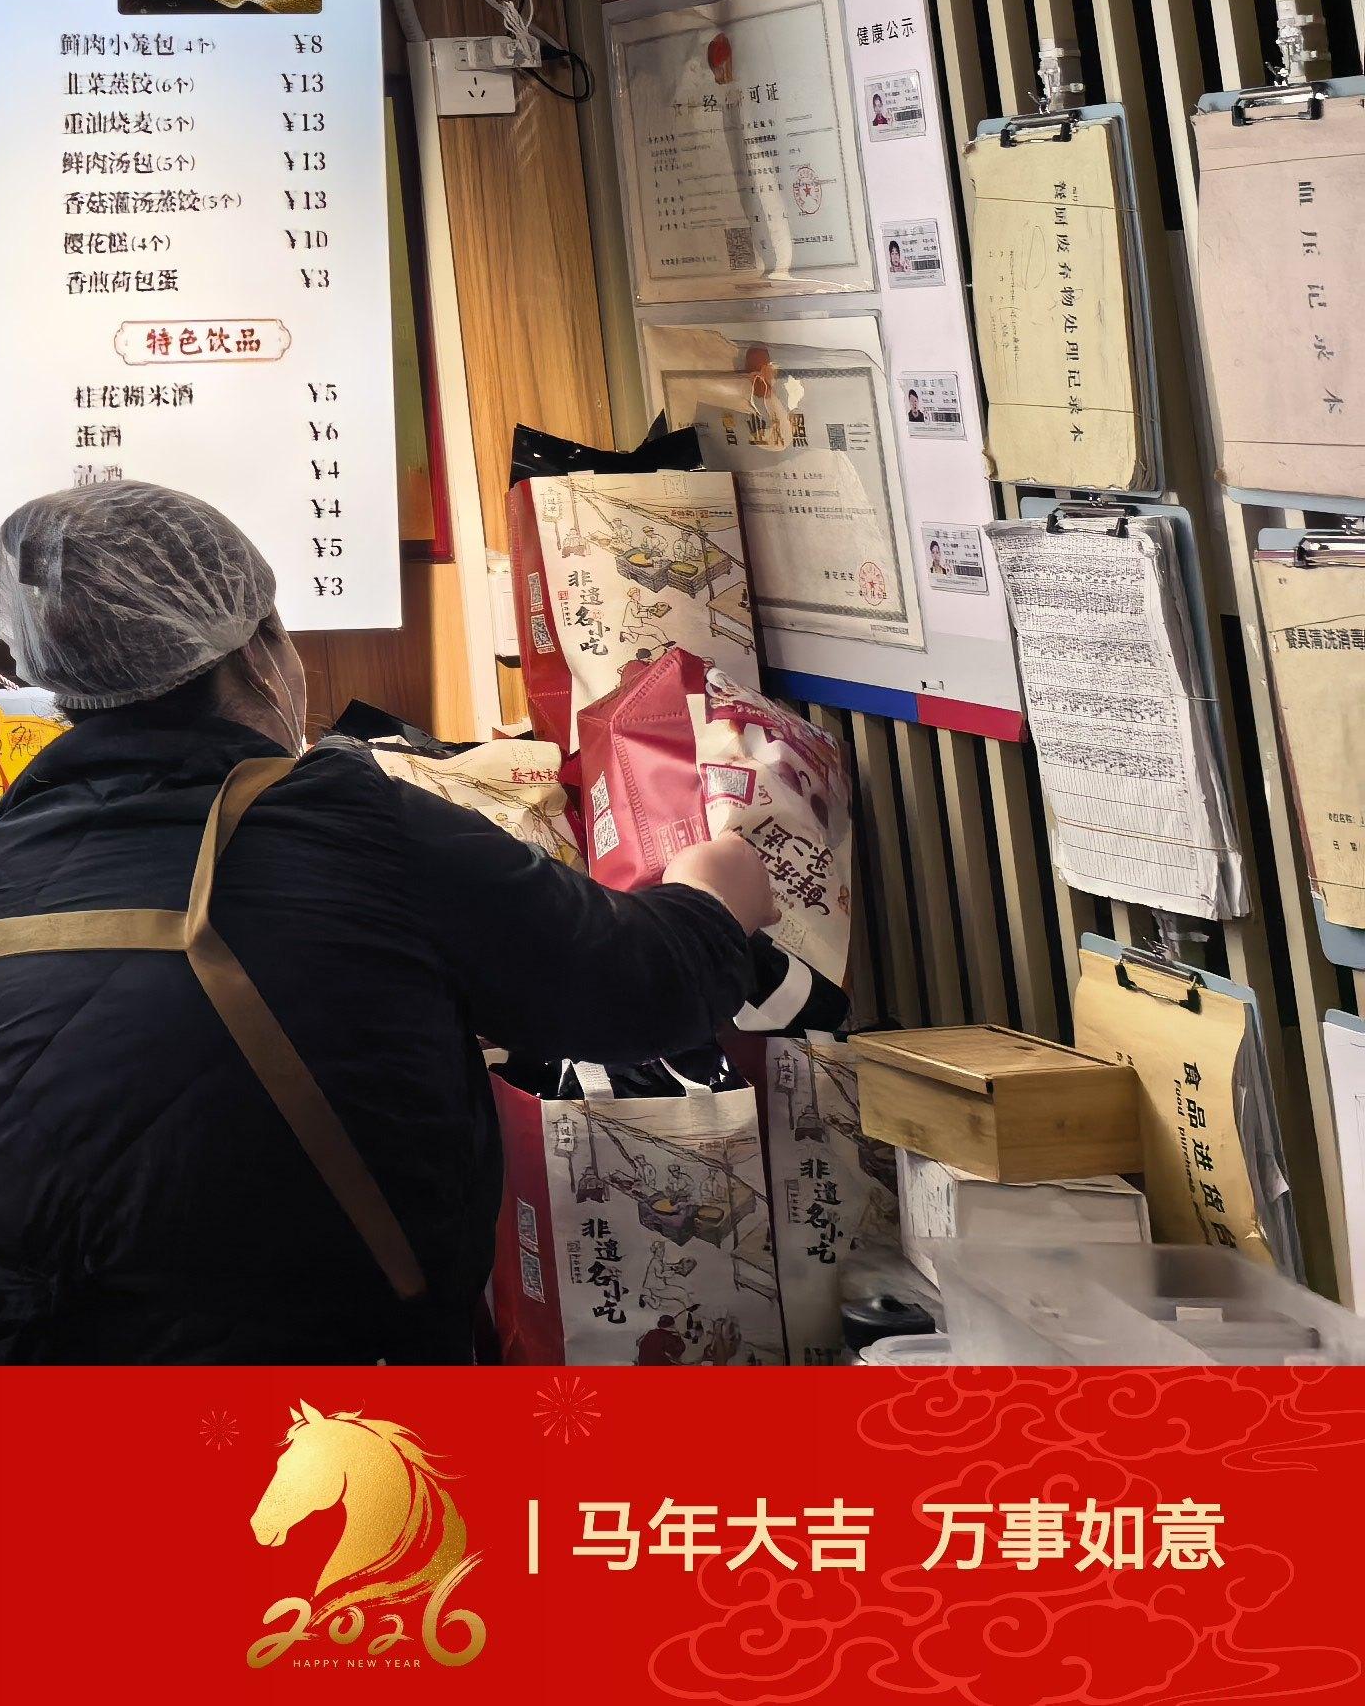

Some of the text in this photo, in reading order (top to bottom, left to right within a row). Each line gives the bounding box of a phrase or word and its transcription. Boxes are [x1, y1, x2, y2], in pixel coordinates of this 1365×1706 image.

[856, 17, 916, 46] 健康公示
[295, 35, 322, 53] ¥8
[282, 73, 323, 93] ¥13
[283, 113, 324, 131] ¥13
[284, 151, 325, 171] ¥13
[284, 191, 326, 210] ¥13
[285, 230, 327, 249] ¥10
[301, 269, 329, 288] ¥3
[146, 327, 261, 355] 特色饮品
[308, 383, 337, 402] ¥5
[76, 421, 338, 447] 蛋酒 ¥6
[311, 460, 339, 479] ¥4
[312, 499, 341, 518] ¥4
[313, 538, 342, 557] ¥5
[314, 577, 343, 596] ¥3
[569, 569, 611, 656] 非遗名小吃
[800, 1158, 844, 1266] 非遗名小吃
[581, 1217, 628, 1325] 非遗名小吃
